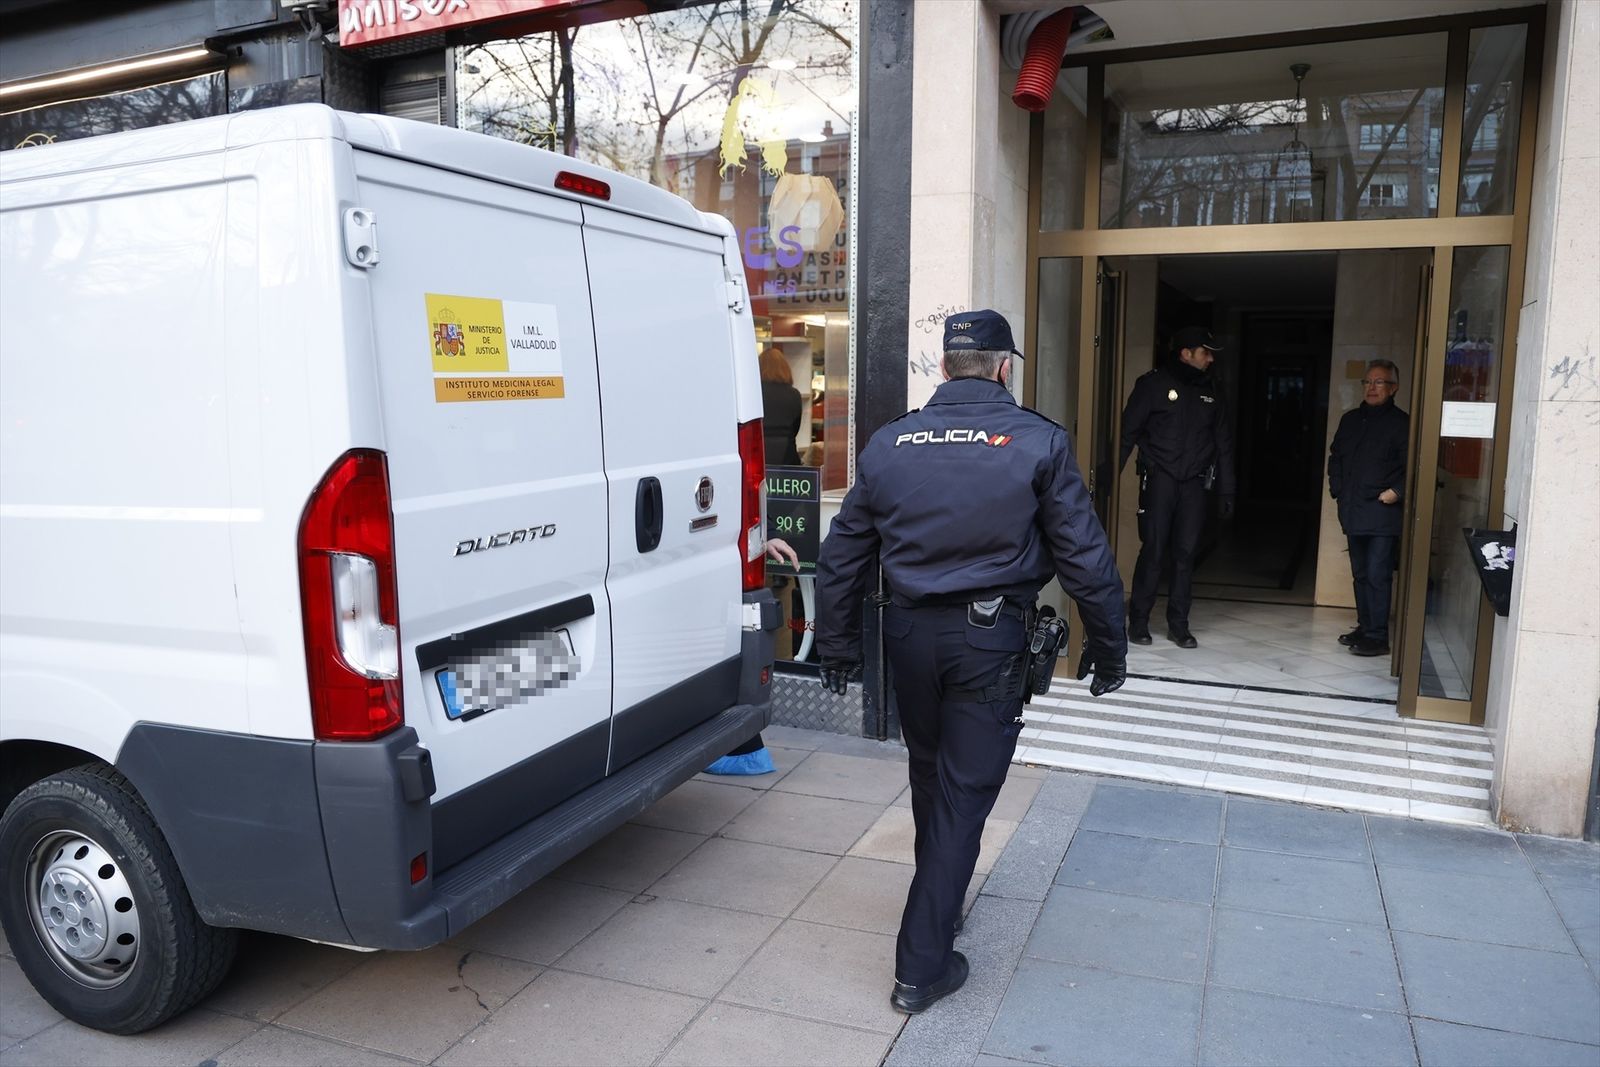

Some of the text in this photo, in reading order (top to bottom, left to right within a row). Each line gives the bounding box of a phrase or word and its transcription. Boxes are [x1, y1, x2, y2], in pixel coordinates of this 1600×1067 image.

[468, 325, 502, 335] MINISTERIO
[523, 325, 543, 336] I.M.L.
[482, 336, 491, 345] DE
[511, 339, 557, 350] VALLADOLID
[475, 346, 500, 355] JUSTICIA
[445, 379, 556, 389] INSTITUTO MEDICINA LEGAL
[467, 389, 539, 399] SERVICIO FORENSE
[895, 429, 989, 446] POLICIA
[776, 516, 793, 531] 90
[453, 523, 557, 557] DUCATO
